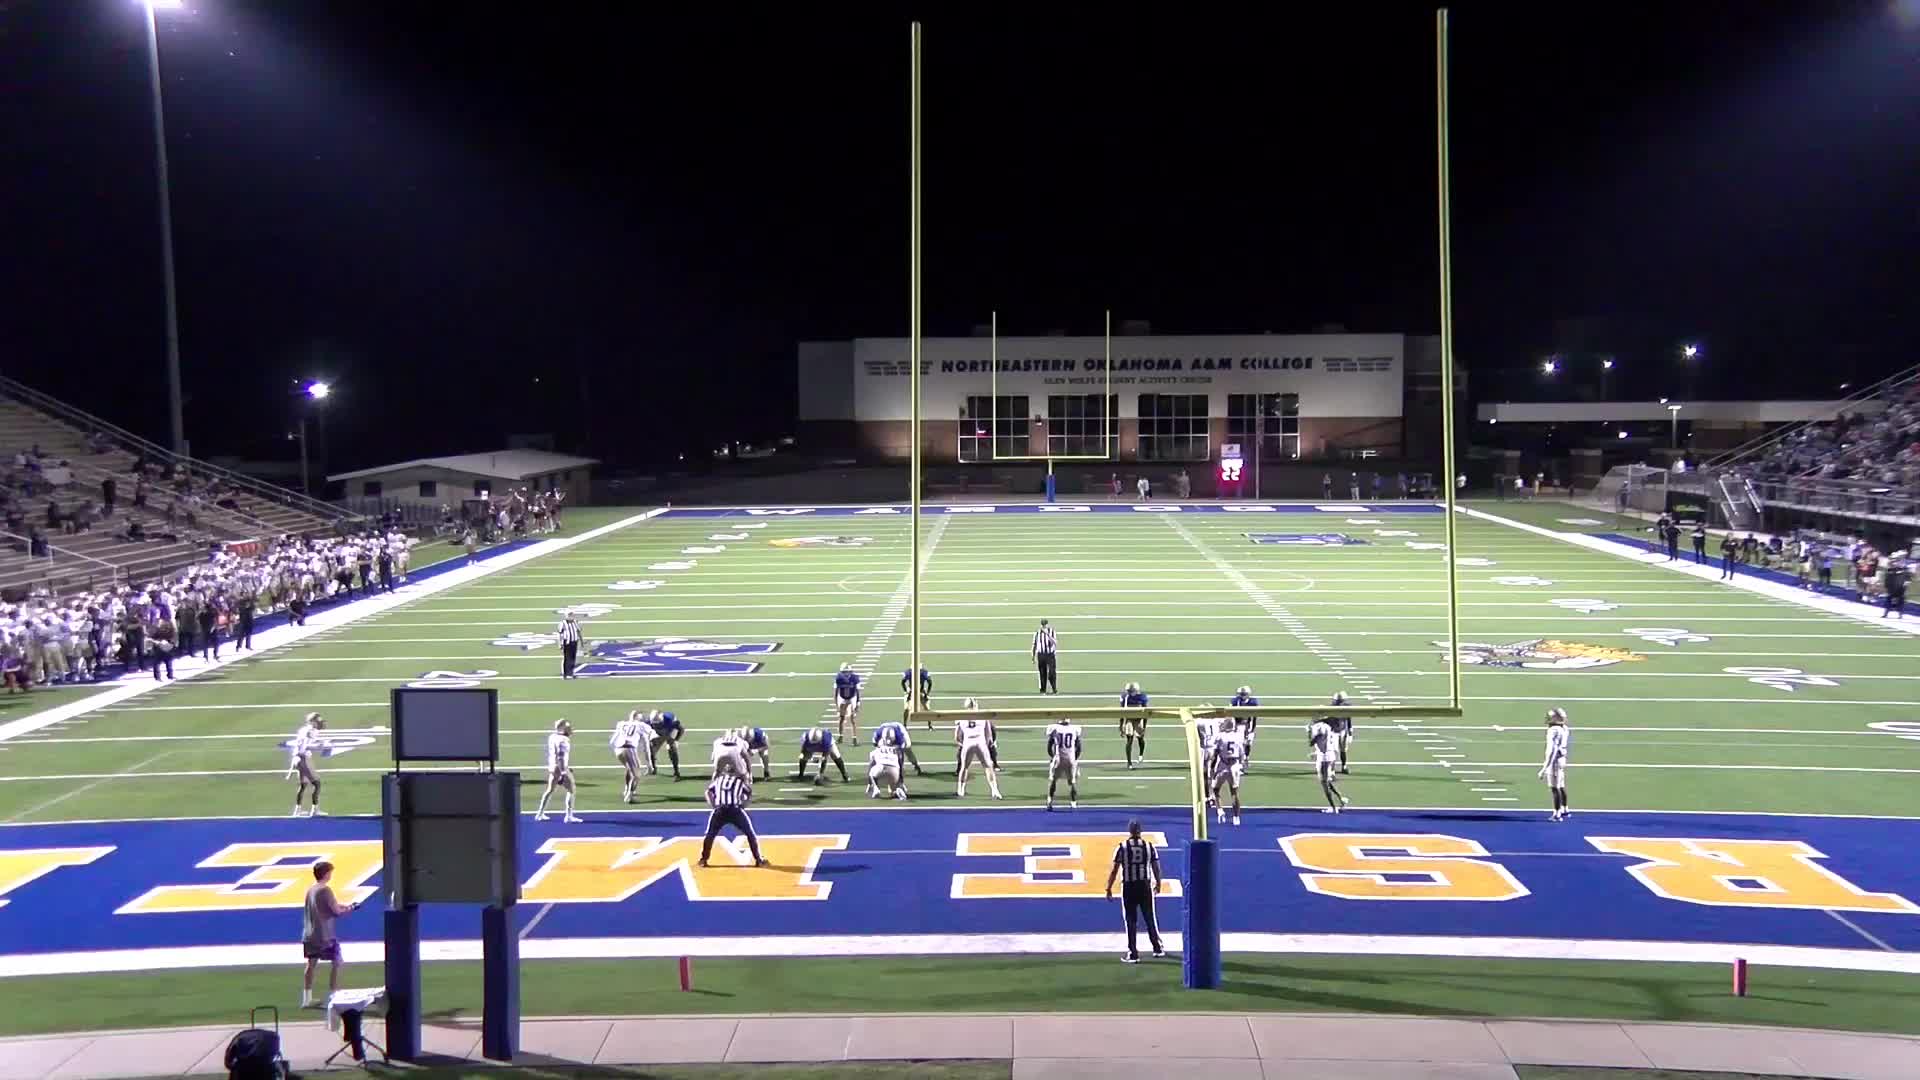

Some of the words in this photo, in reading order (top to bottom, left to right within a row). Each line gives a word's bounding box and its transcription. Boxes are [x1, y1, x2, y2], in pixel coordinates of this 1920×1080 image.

[941, 359, 1076, 372] NORTHEASTERN
[1083, 358, 1183, 371] OKLAHOMA
[1191, 358, 1232, 370] A&M
[1239, 357, 1313, 370] COLLEGE
[406, 669, 499, 689] 20
[1722, 666, 1840, 687] 20
[1057, 732, 1073, 749] 10
[1226, 741, 1236, 755] 5
[1131, 846, 1144, 863] B
